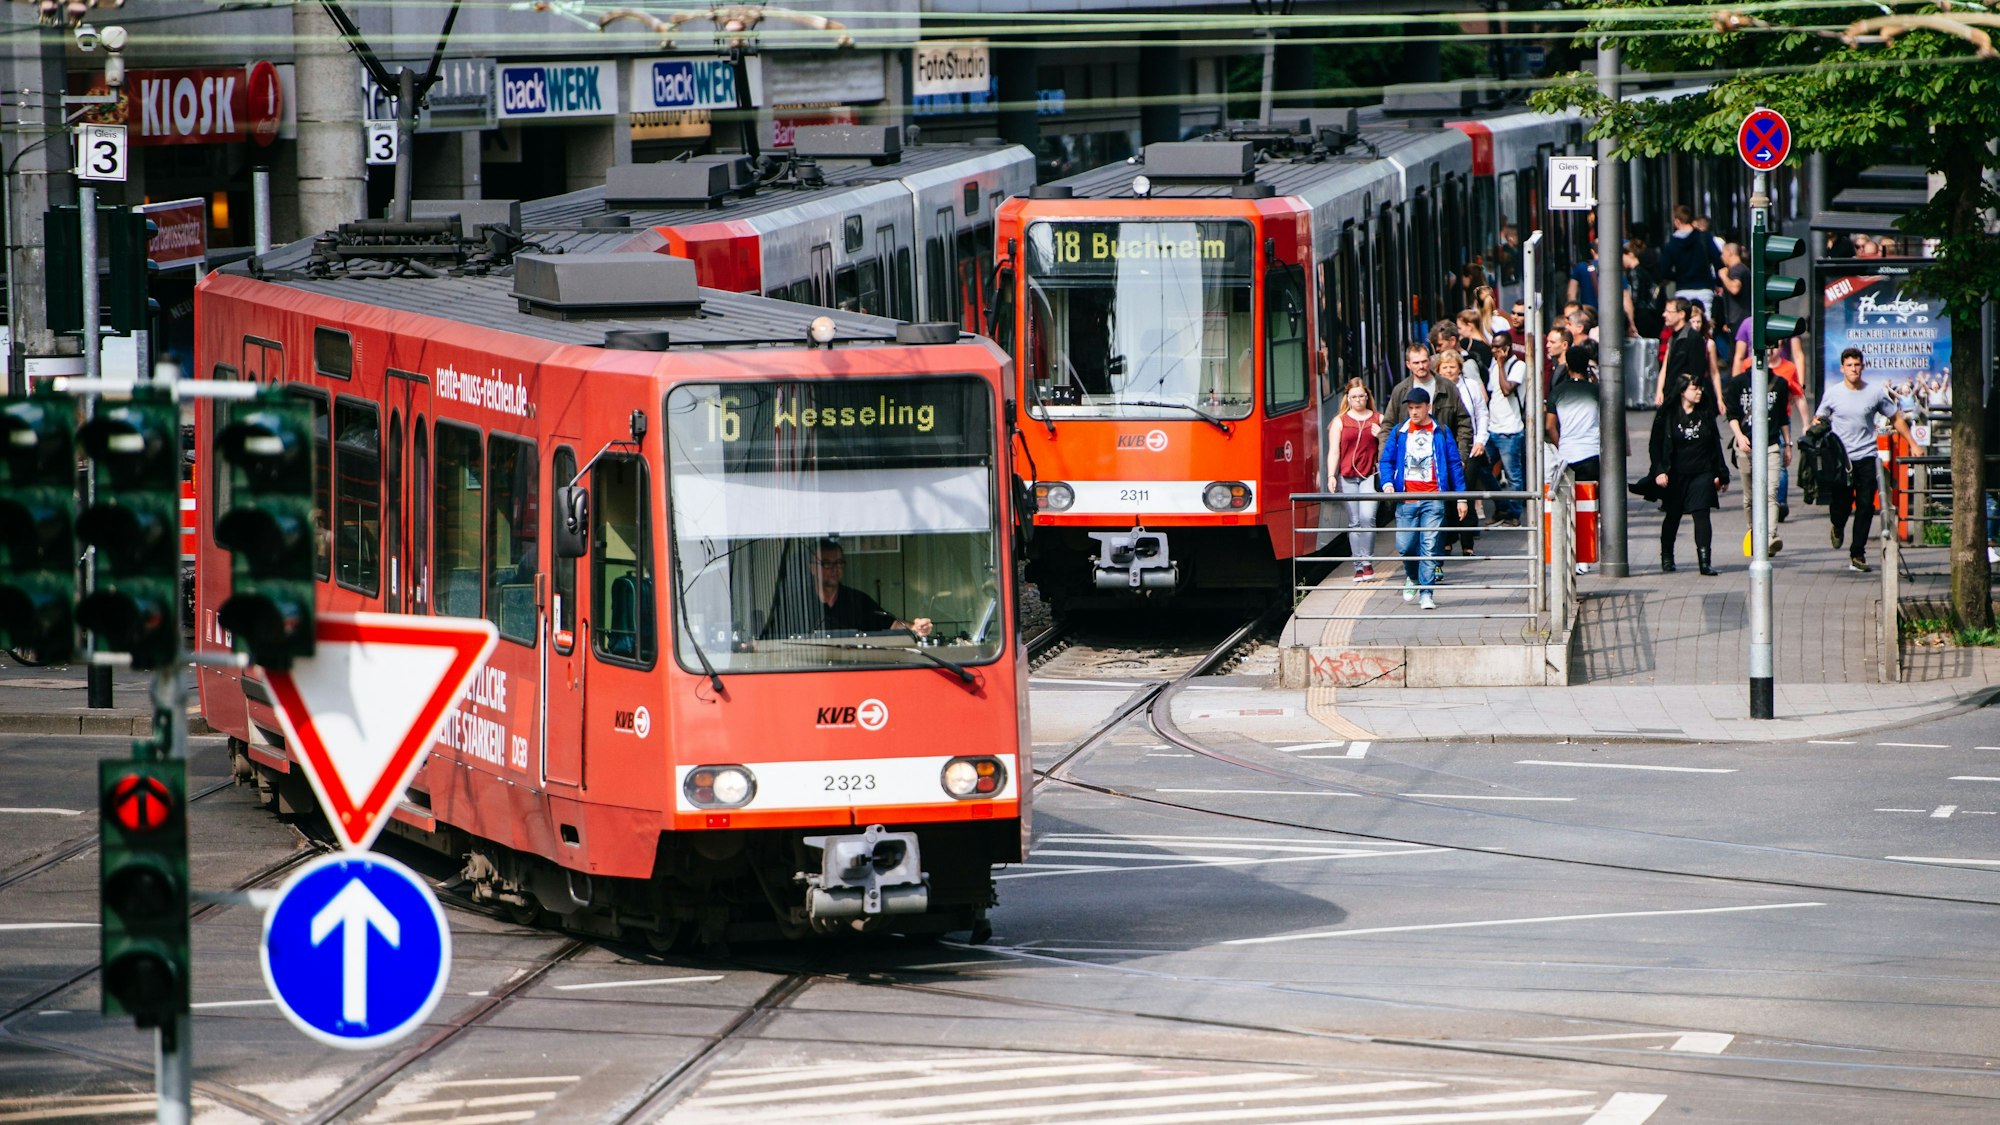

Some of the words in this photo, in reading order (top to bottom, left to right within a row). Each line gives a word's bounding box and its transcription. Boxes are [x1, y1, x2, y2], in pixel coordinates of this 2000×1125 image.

[918, 51, 985, 81] FotoStudio
[655, 60, 735, 104] backWER
[141, 76, 236, 136] KIOSK
[94, 128, 117, 139] Gleis
[92, 140, 118, 174] 3
[375, 134, 393, 160] 3
[1558, 162, 1579, 171] Gleis
[1560, 173, 1581, 203] 4
[1054, 230, 1081, 263] 18
[1092, 232, 1226, 260] Buchheim
[1825, 279, 1854, 302] NEU!
[1858, 290, 1929, 316] Phantasia
[1858, 315, 1929, 324] LAND
[1847, 329, 1864, 339] EINE
[1866, 329, 1885, 339] NEUE
[1887, 328, 1937, 339] THEMENWELT
[1862, 342, 1933, 355] ACHTERBAHNEN
[1865, 357, 1929, 369] WELTREKORDE
[436, 363, 527, 417] rente-muss-reichen.de
[705, 396, 741, 443] 16
[774, 395, 935, 432] Wesseling
[1117, 435, 1146, 448] KVB
[1120, 489, 1150, 502] 2311
[615, 711, 634, 729] KVB
[816, 706, 857, 724] KVB
[512, 735, 528, 769] DGB
[824, 774, 876, 791] 2323
